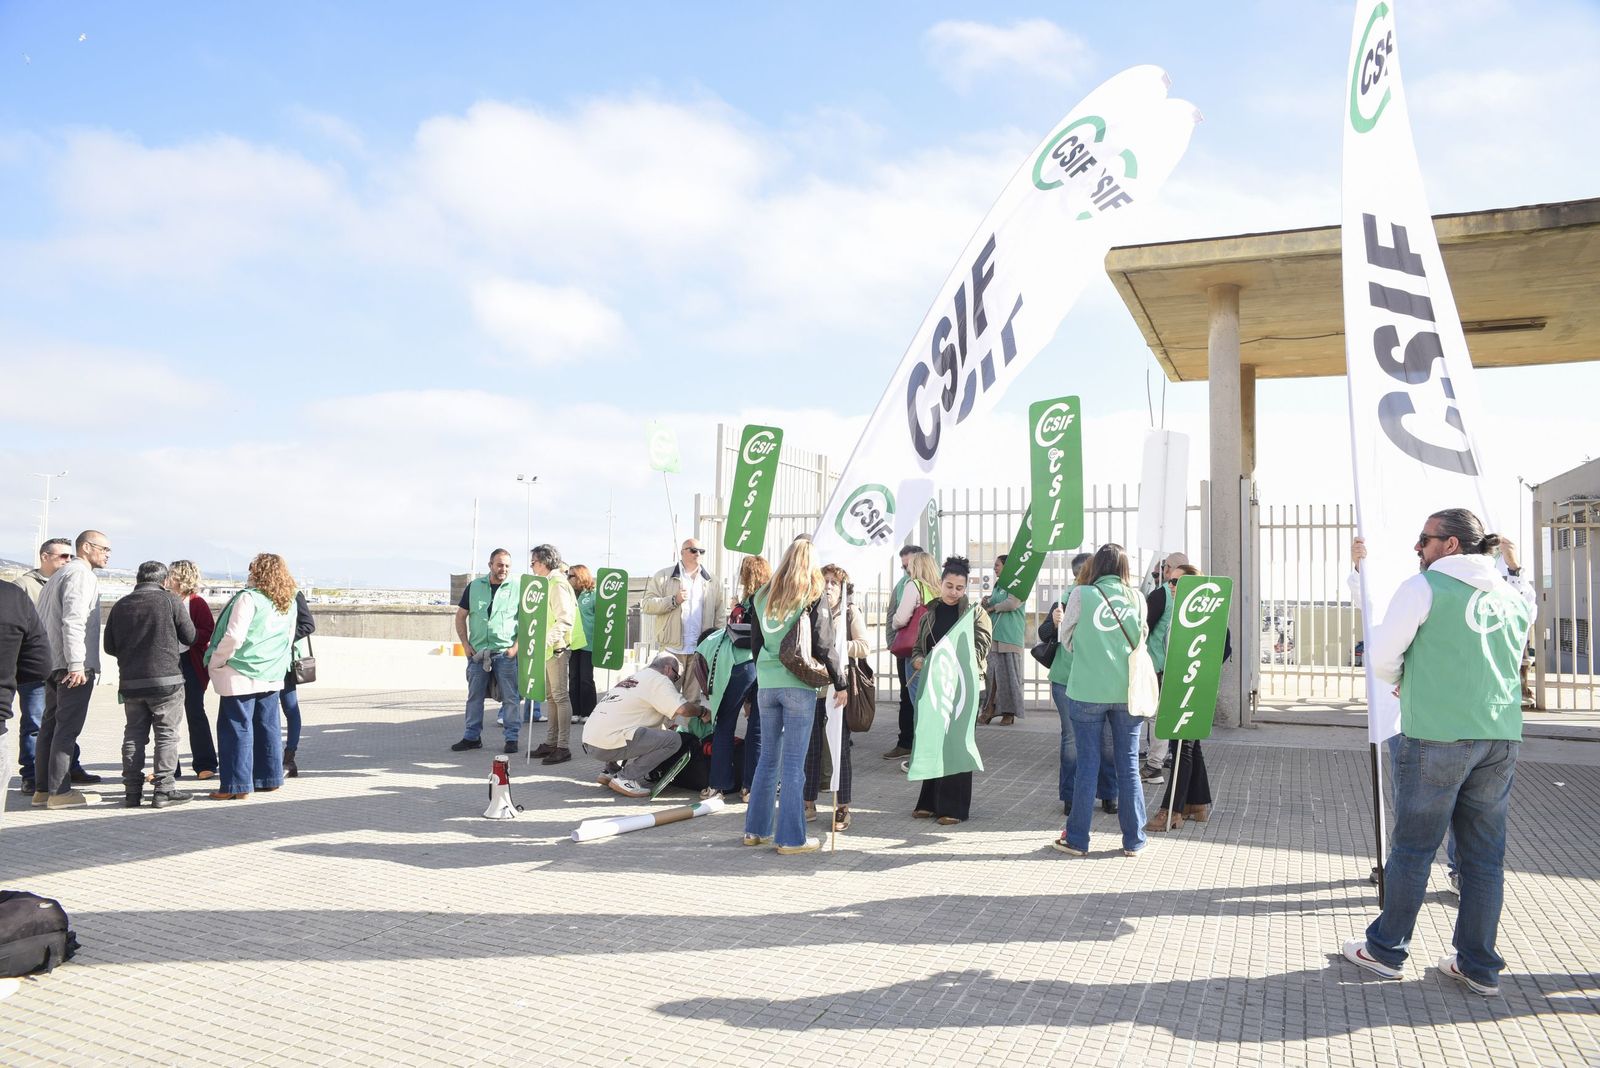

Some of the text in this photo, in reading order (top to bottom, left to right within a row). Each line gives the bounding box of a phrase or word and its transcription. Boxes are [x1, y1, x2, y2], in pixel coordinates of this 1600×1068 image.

[1051, 135, 1098, 178] CSIF
[1090, 167, 1134, 212] SIF
[906, 231, 997, 461] CSIF
[1362, 212, 1479, 477] CSIF
[735, 469, 763, 547] CSIF
[849, 498, 894, 541] CSIF
[1048, 448, 1065, 545] CSIF
[526, 618, 538, 694] CSIF
[601, 603, 617, 665] CSIF
[1172, 633, 1207, 734] CSIF
